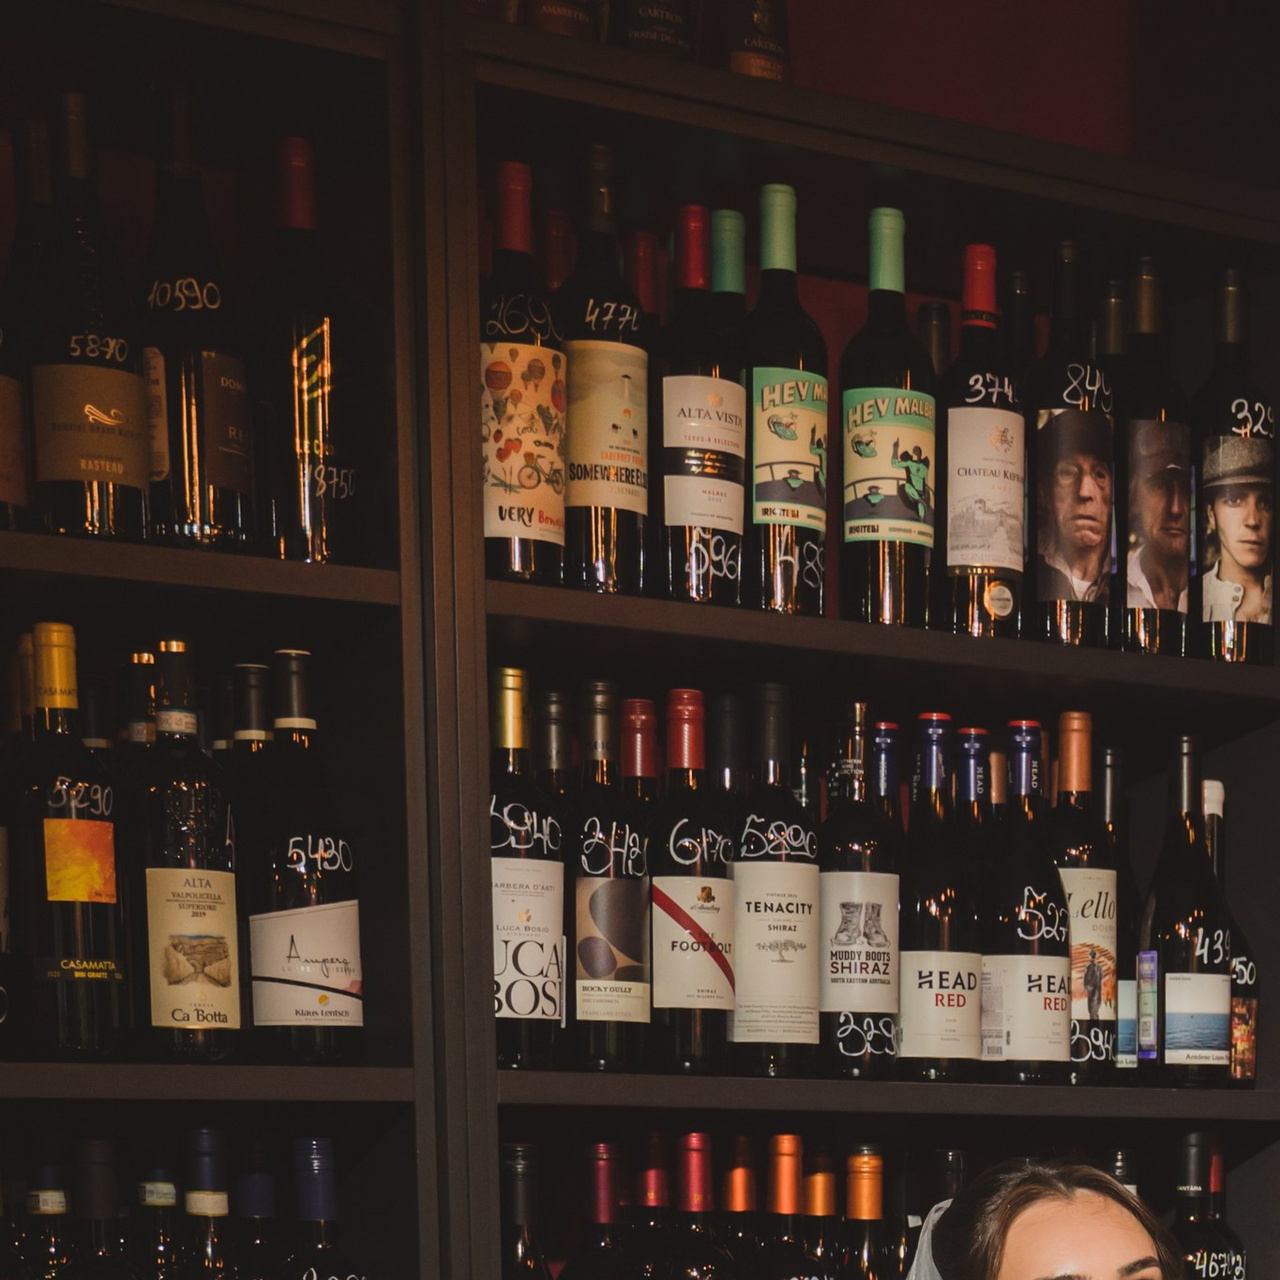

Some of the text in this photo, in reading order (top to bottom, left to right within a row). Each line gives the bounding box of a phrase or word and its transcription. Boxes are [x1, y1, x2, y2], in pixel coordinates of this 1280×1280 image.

[761, 380, 808, 411] HEY
[677, 406, 744, 428] ALTA VISTA
[848, 397, 888, 433] HEY
[957, 466, 998, 481] CHATEAU
[498, 505, 534, 528] VERY
[183, 877, 212, 889] ALTA
[494, 883, 530, 892] ARBERA
[171, 891, 222, 902] VALPOLICELLA
[746, 901, 813, 916] TENACITY
[496, 924, 520, 933] LUCA
[768, 923, 797, 933] SHIRAZ
[830, 950, 891, 963] MUDDY BOOTS
[61, 959, 116, 971] CASAMATTA
[830, 961, 890, 976] SHIRAZ
[918, 970, 977, 990] HEAD
[582, 985, 633, 994] ROCKY GULLY
[935, 993, 967, 1008] RED
[1043, 997, 1068, 1012] RED
[295, 1006, 318, 1018] Klaus
